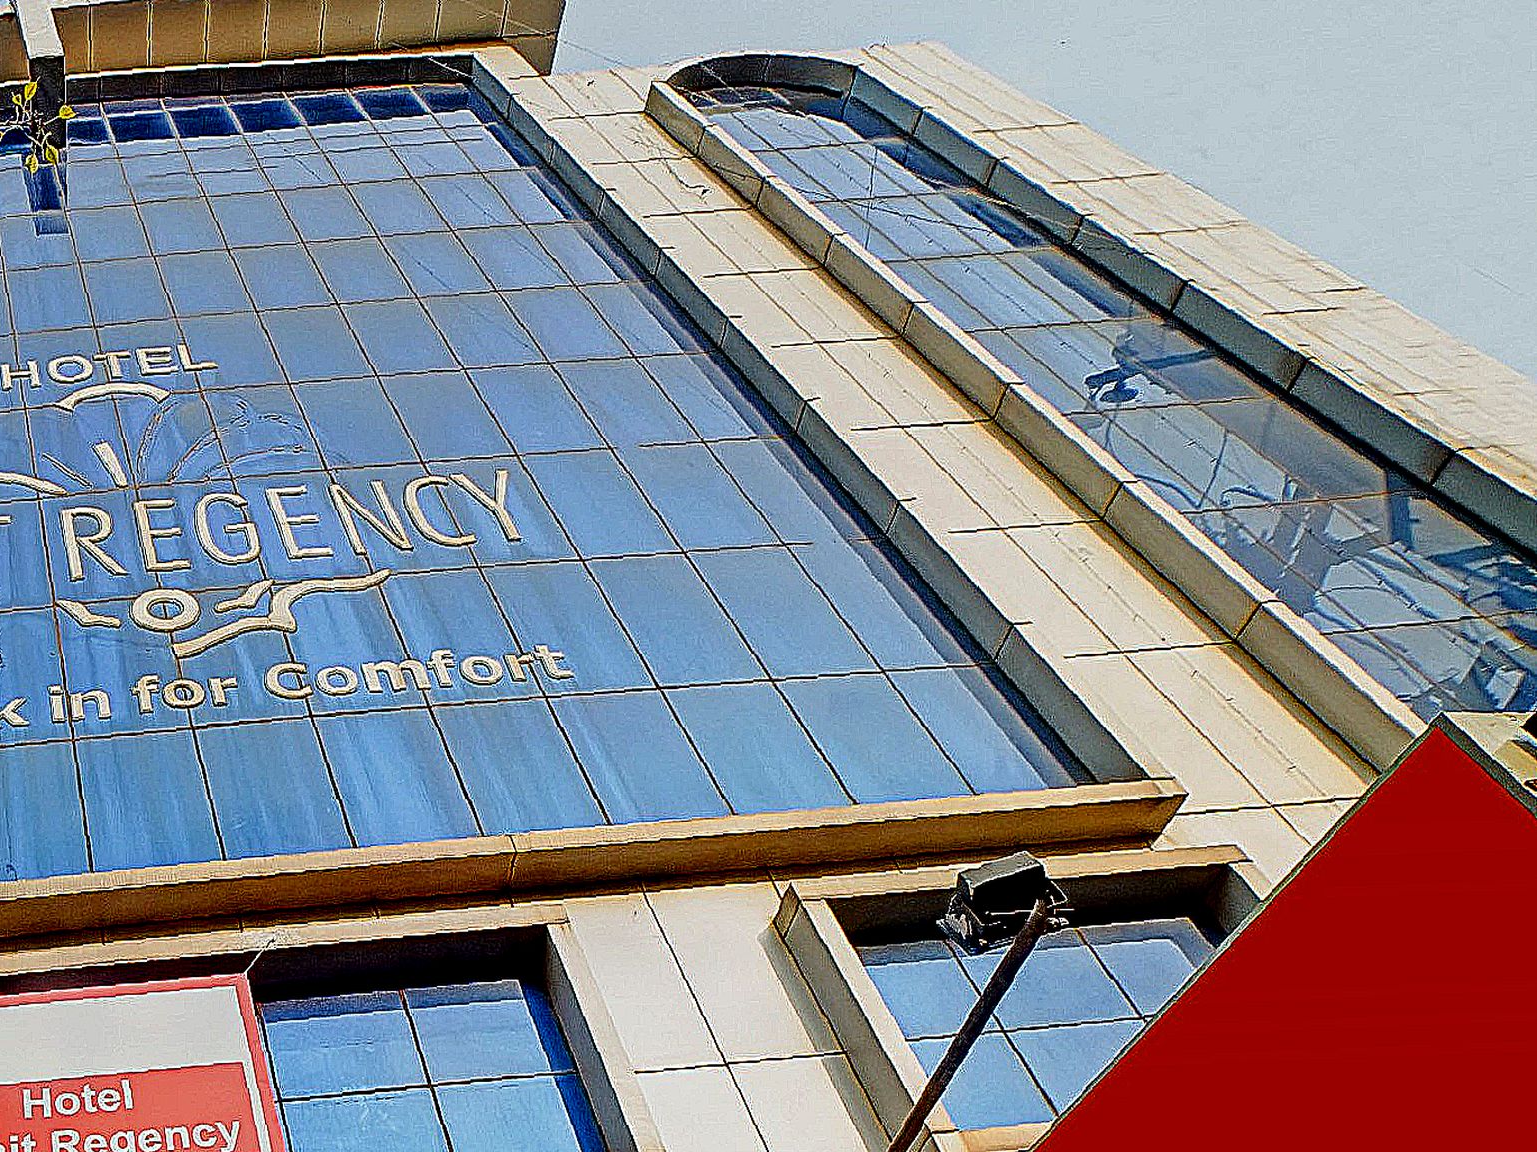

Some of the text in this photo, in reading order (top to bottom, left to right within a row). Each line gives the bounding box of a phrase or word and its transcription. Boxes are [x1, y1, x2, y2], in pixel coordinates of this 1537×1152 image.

[0, 342, 218, 392] HOTEL
[58, 468, 524, 584] REGENCY
[47, 684, 111, 724] in
[131, 674, 238, 714] for
[264, 645, 574, 699] Comfort
[21, 1078, 135, 1120] Hotel
